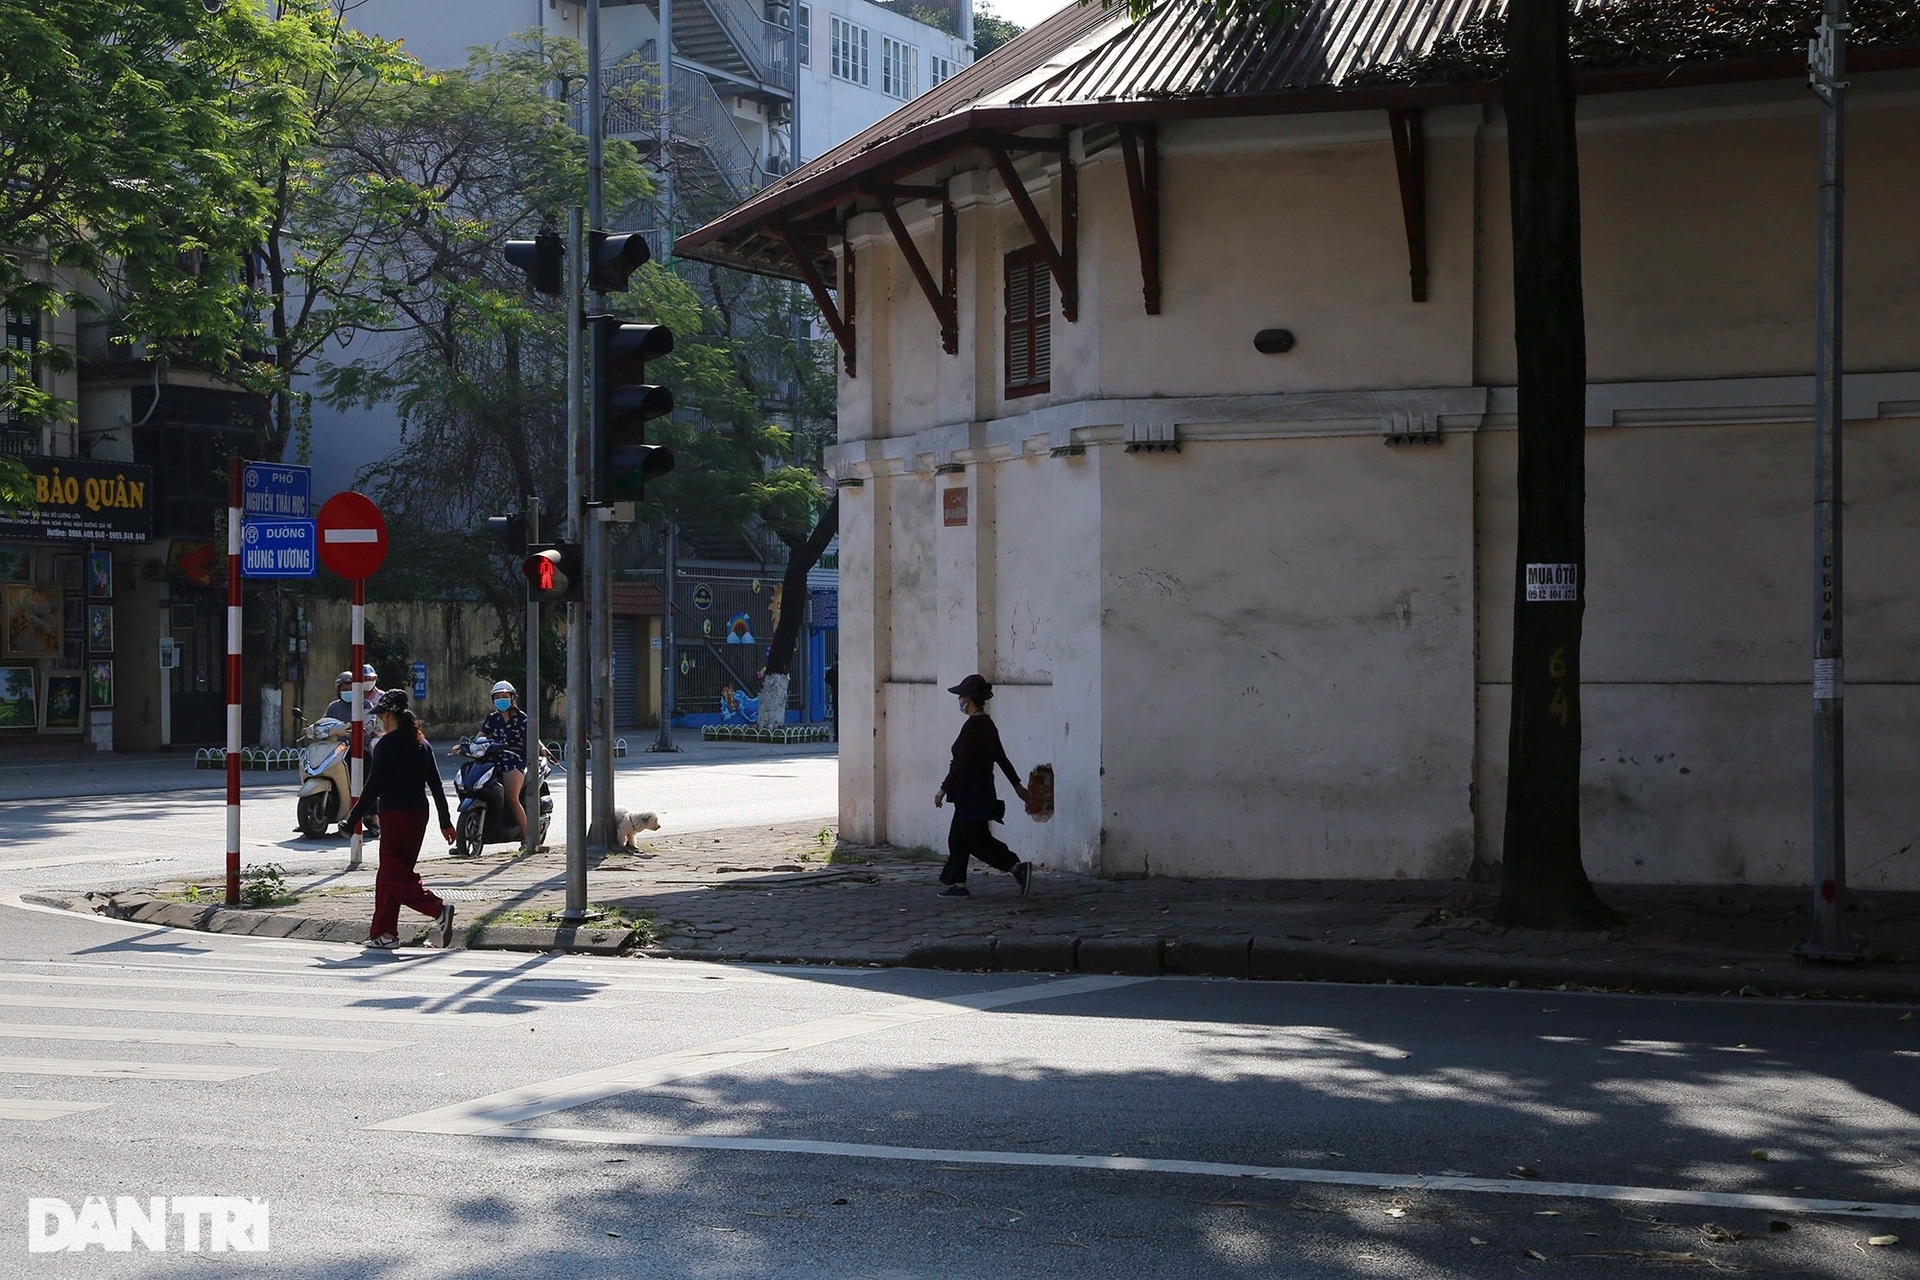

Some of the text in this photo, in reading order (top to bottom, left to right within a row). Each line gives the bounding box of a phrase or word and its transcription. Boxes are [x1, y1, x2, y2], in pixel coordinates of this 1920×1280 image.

[272, 470, 294, 484] PHỐ
[36, 467, 144, 511] BẢO QUÂN
[275, 491, 291, 513] THÁI
[292, 495, 305, 517] HỌC
[46, 528, 67, 537] Hotline:
[266, 525, 305, 539] ĐƯỜNG
[247, 545, 310, 569] HÙNG VƯƠNG
[1528, 565, 1575, 585] MUA ÔTÔ
